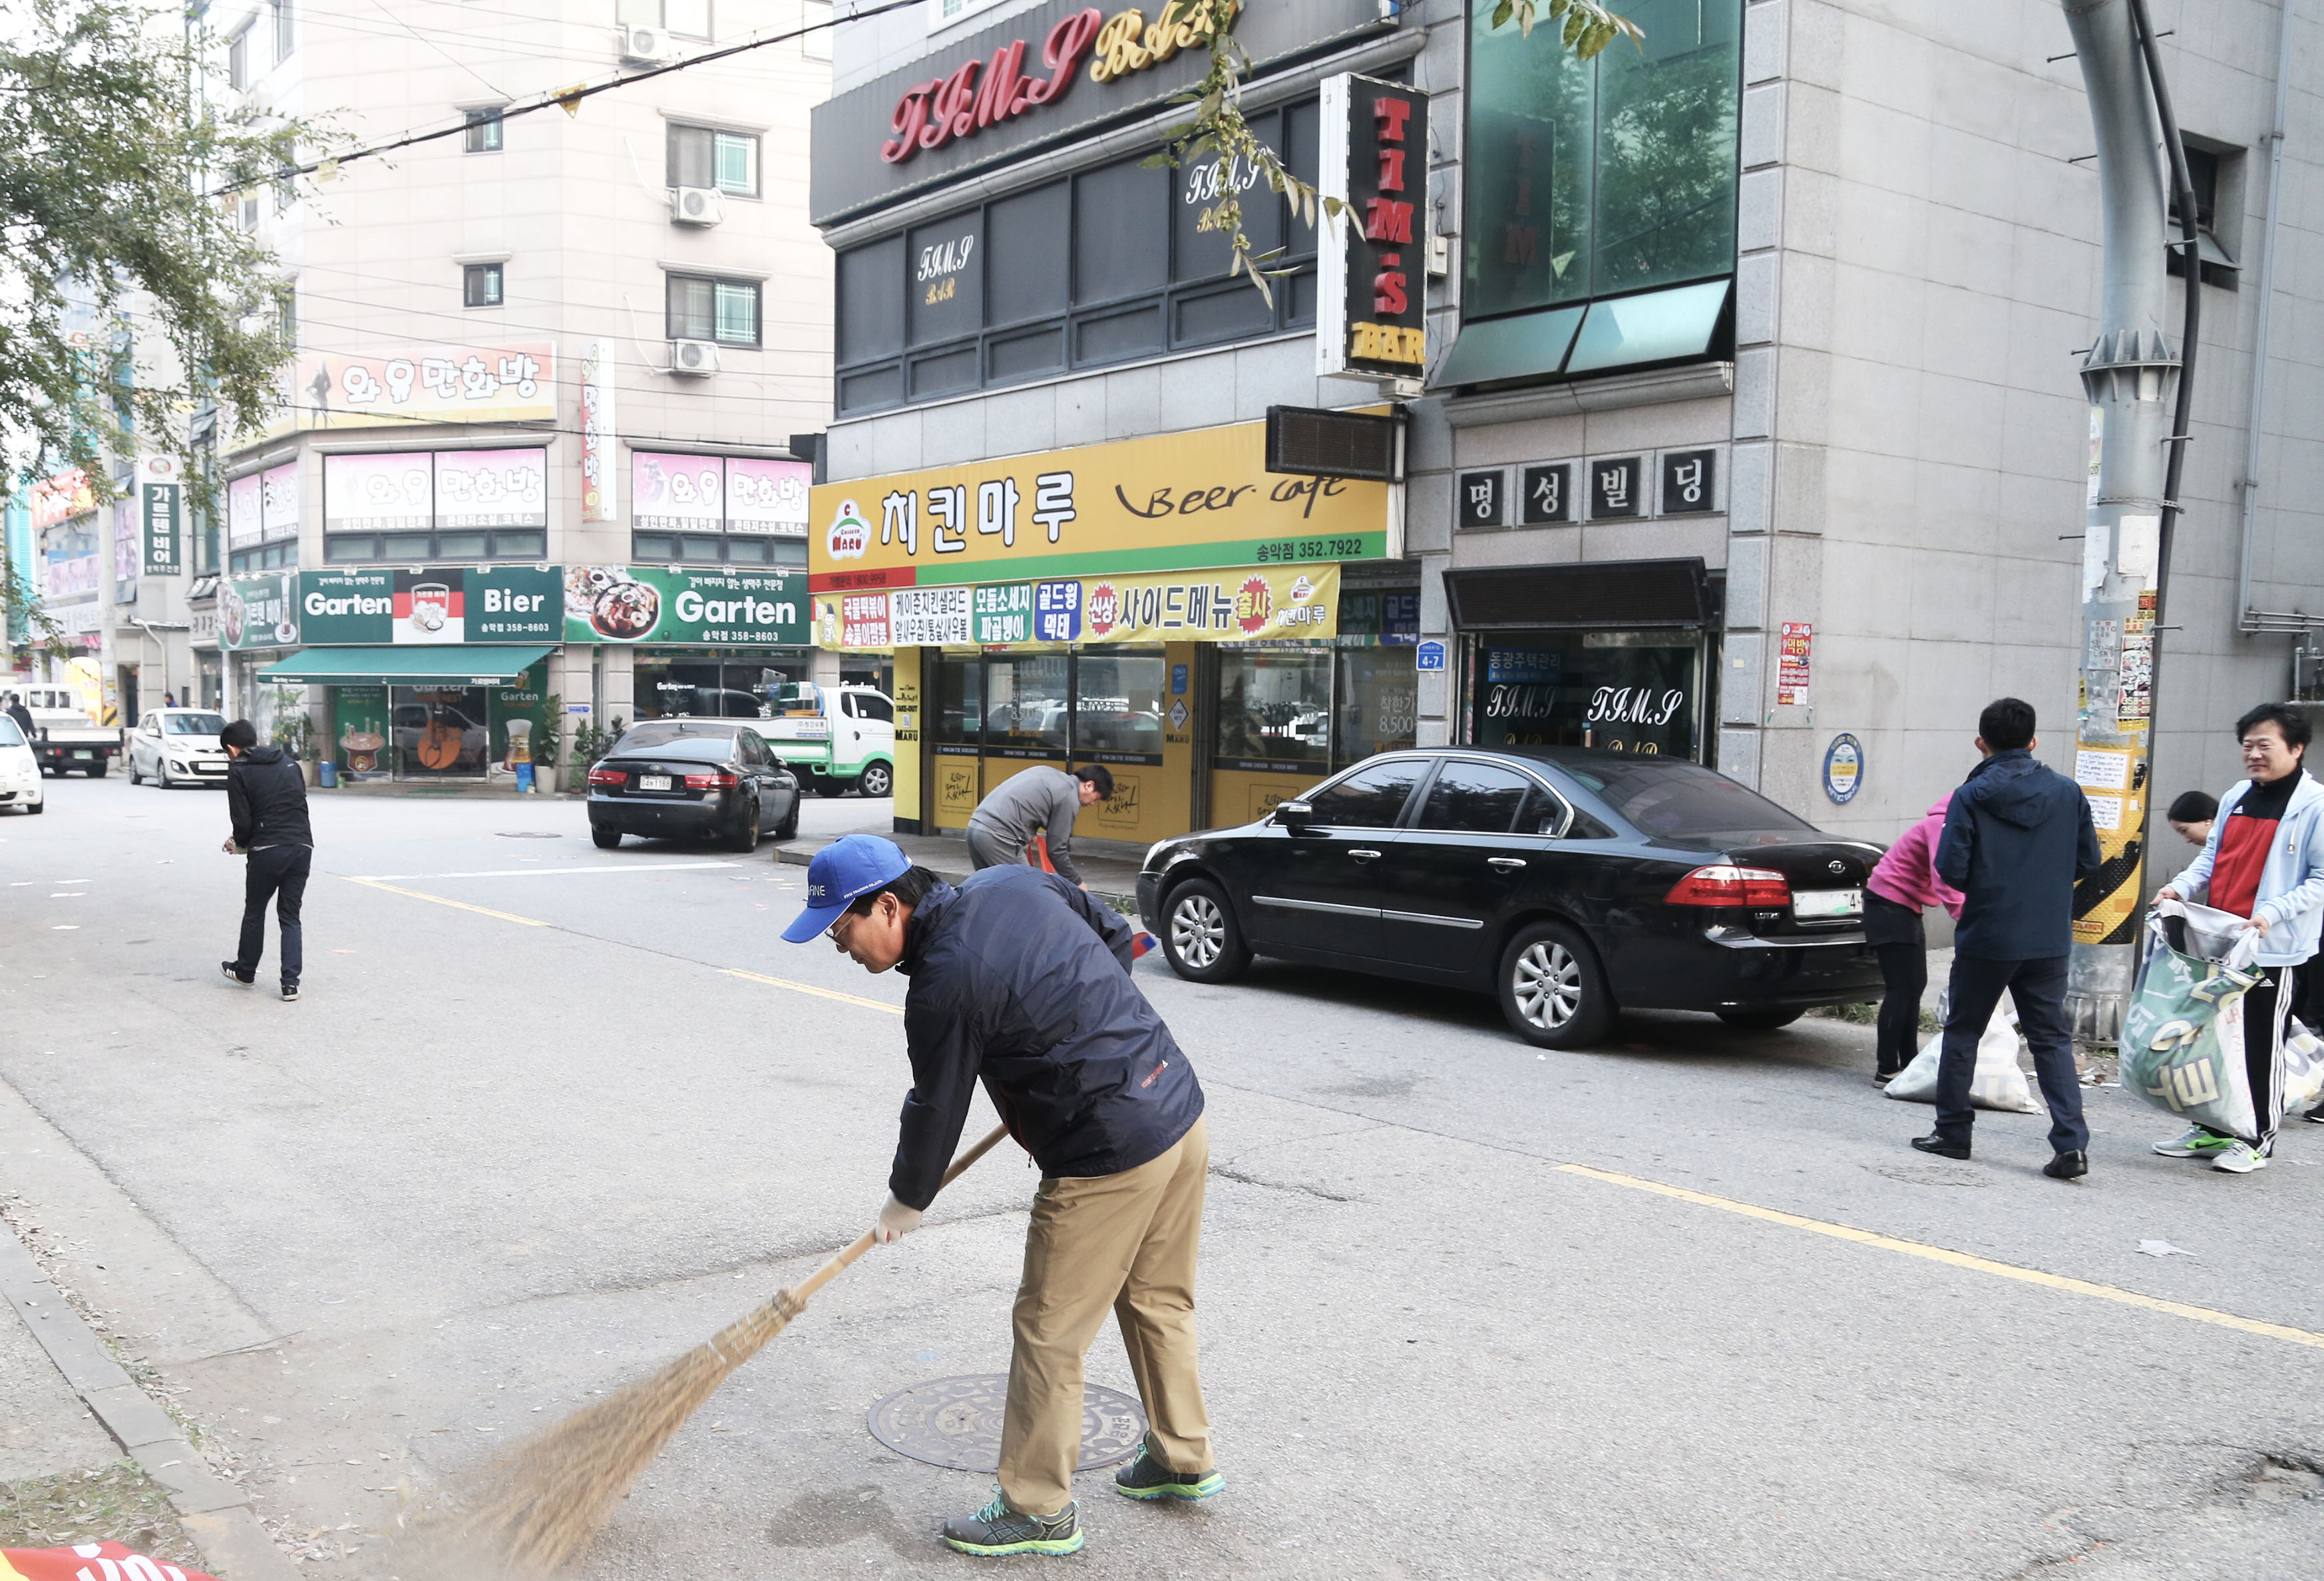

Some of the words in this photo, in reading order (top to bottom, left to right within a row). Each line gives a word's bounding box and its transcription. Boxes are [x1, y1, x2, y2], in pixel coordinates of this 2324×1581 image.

[926, 277, 956, 306] BAR
[1351, 321, 1426, 365] BAR
[880, 470, 1077, 556] 치킨마루
[833, 536, 862, 552] MARU
[1257, 542, 1294, 561] 송악점
[1299, 538, 1362, 558] 352.7922
[305, 592, 392, 616] Garten
[484, 588, 544, 612] Bier
[675, 590, 796, 624] Garten
[976, 584, 1030, 614] 모듬소세지
[1039, 583, 1079, 612] 골드윙
[1088, 600, 1114, 624] 신상
[1238, 590, 1268, 619] 출시
[481, 623, 504, 632] 송악점
[506, 623, 549, 631] 358-8603
[702, 631, 728, 641] 송악점
[731, 631, 779, 641] 358-8603
[980, 614, 1024, 642] 파골뱅이
[1044, 613, 1069, 640] 먹태
[1422, 655, 1440, 666] 4-7
[500, 691, 538, 701] Garten
